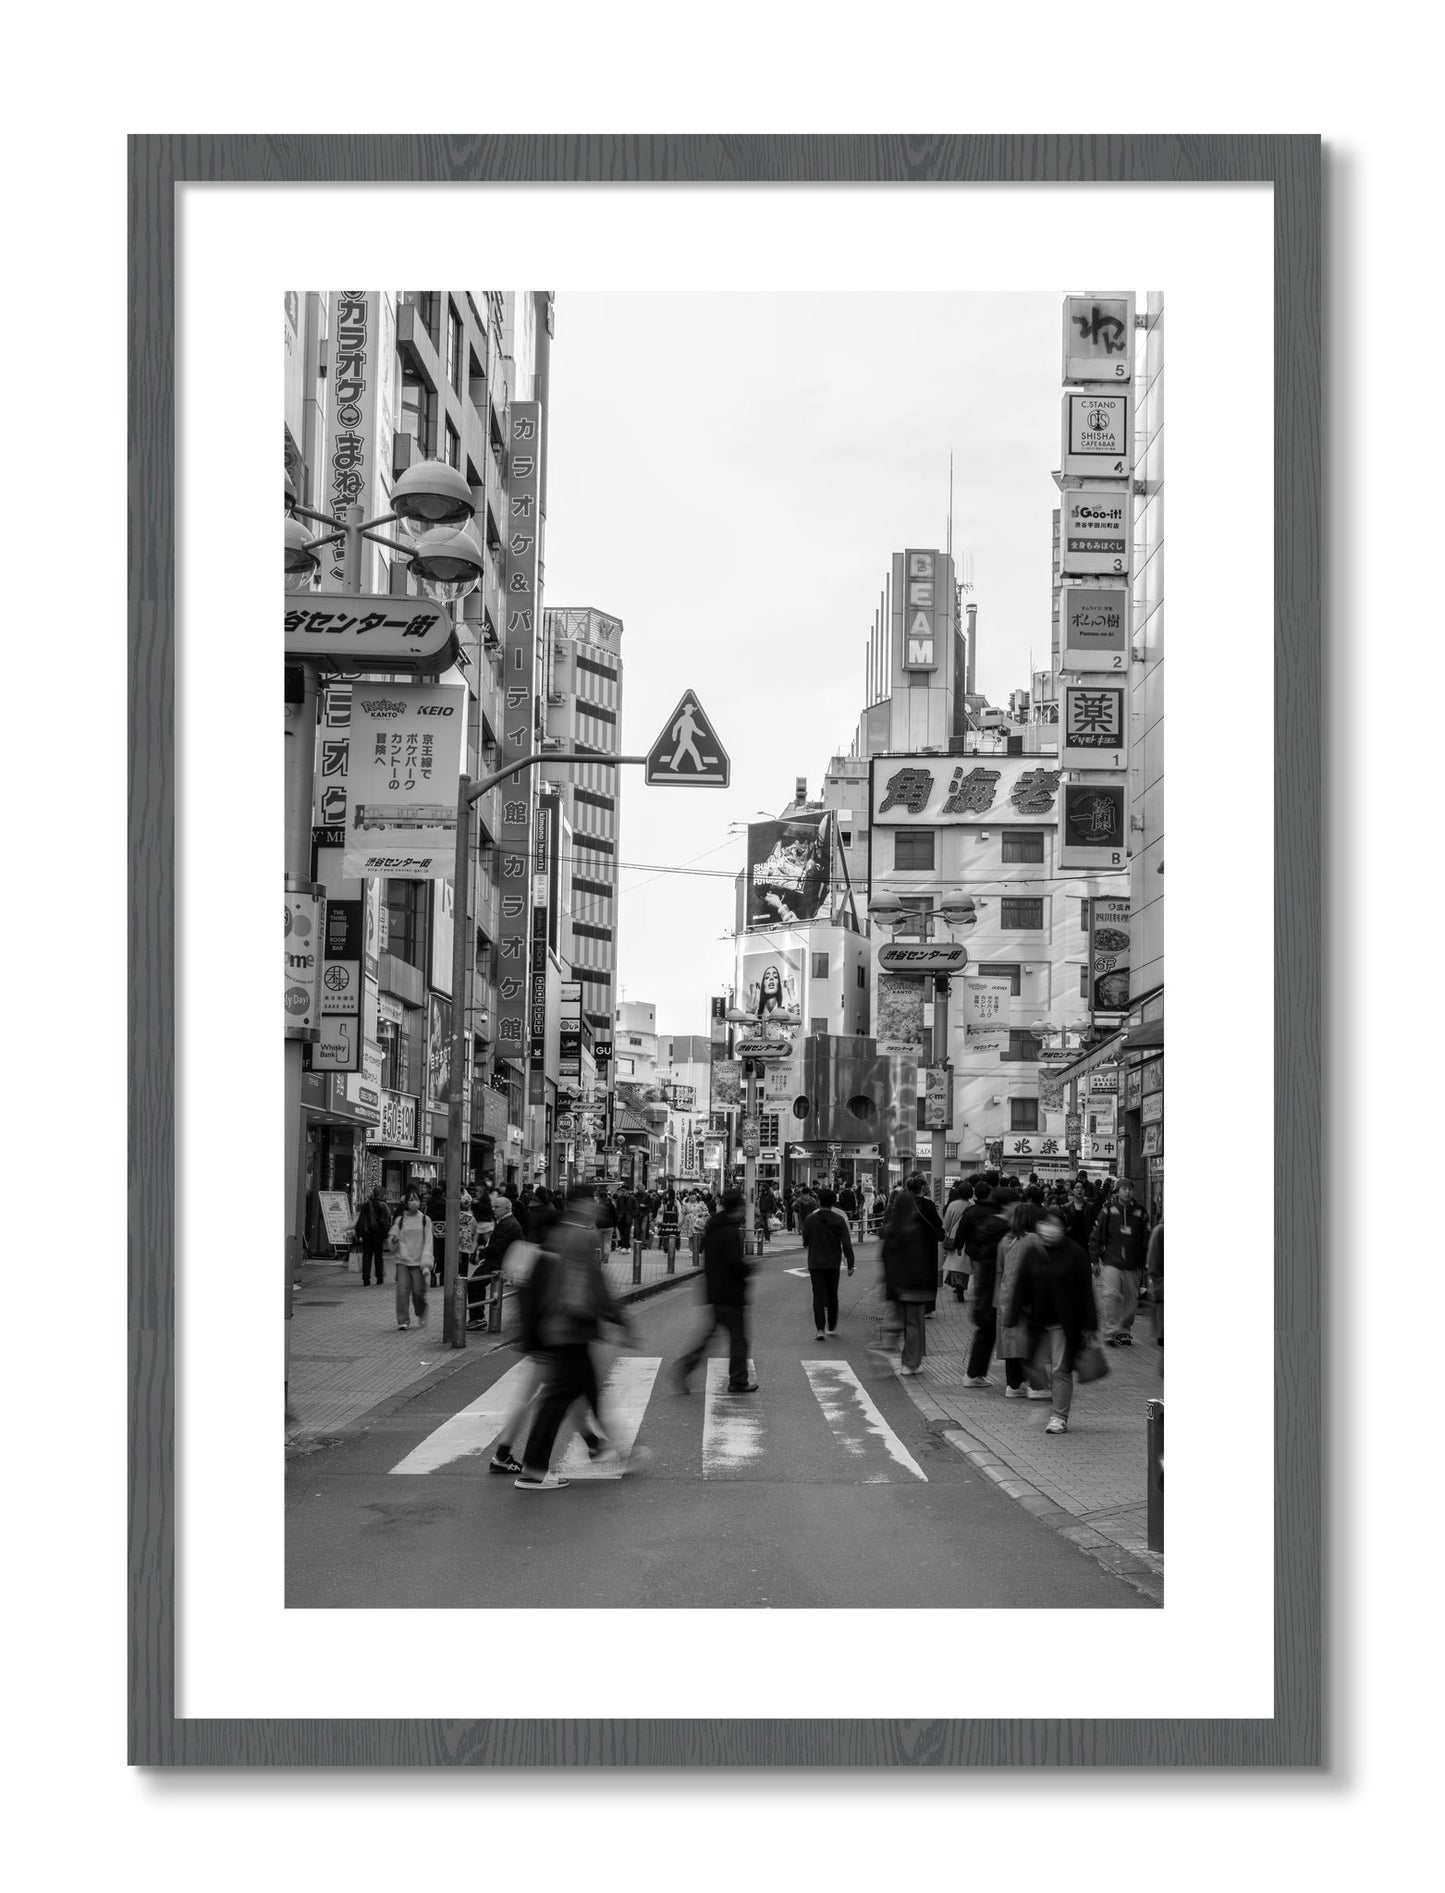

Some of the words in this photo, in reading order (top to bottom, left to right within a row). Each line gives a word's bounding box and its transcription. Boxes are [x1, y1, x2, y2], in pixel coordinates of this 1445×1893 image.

[336, 300, 367, 405] カラオケ
[1115, 365, 1125, 376] 5
[1081, 400, 1116, 409] C.STAND
[1081, 432, 1116, 440] SHISHA
[1114, 461, 1124, 473] 4
[1080, 506, 1122, 519] Goo-it!
[1070, 541, 1123, 550] 全身もみほぐし
[1113, 558, 1122, 571] 3
[909, 553, 935, 664] BEAM
[1113, 656, 1122, 668] 2
[416, 706, 454, 717] KEIO
[1074, 693, 1113, 733] 薬
[374, 733, 387, 766] 冒険へ
[389, 734, 402, 790] カントーの
[404, 734, 418, 790] ポケパーク
[421, 734, 433, 780] 京王線で
[1113, 754, 1119, 766] 1
[879, 767, 1061, 814] 角海老
[537, 812, 546, 840] kimono
[364, 857, 433, 868] 渋谷センター街
[536, 843, 545, 871] hearts
[1111, 853, 1121, 865] B
[499, 856, 526, 1041] カラオケ館
[884, 950, 962, 961] 渋谷センター街
[1093, 956, 1117, 973] 6F
[320, 1043, 346, 1053] Whisky
[595, 1046, 612, 1055] GU
